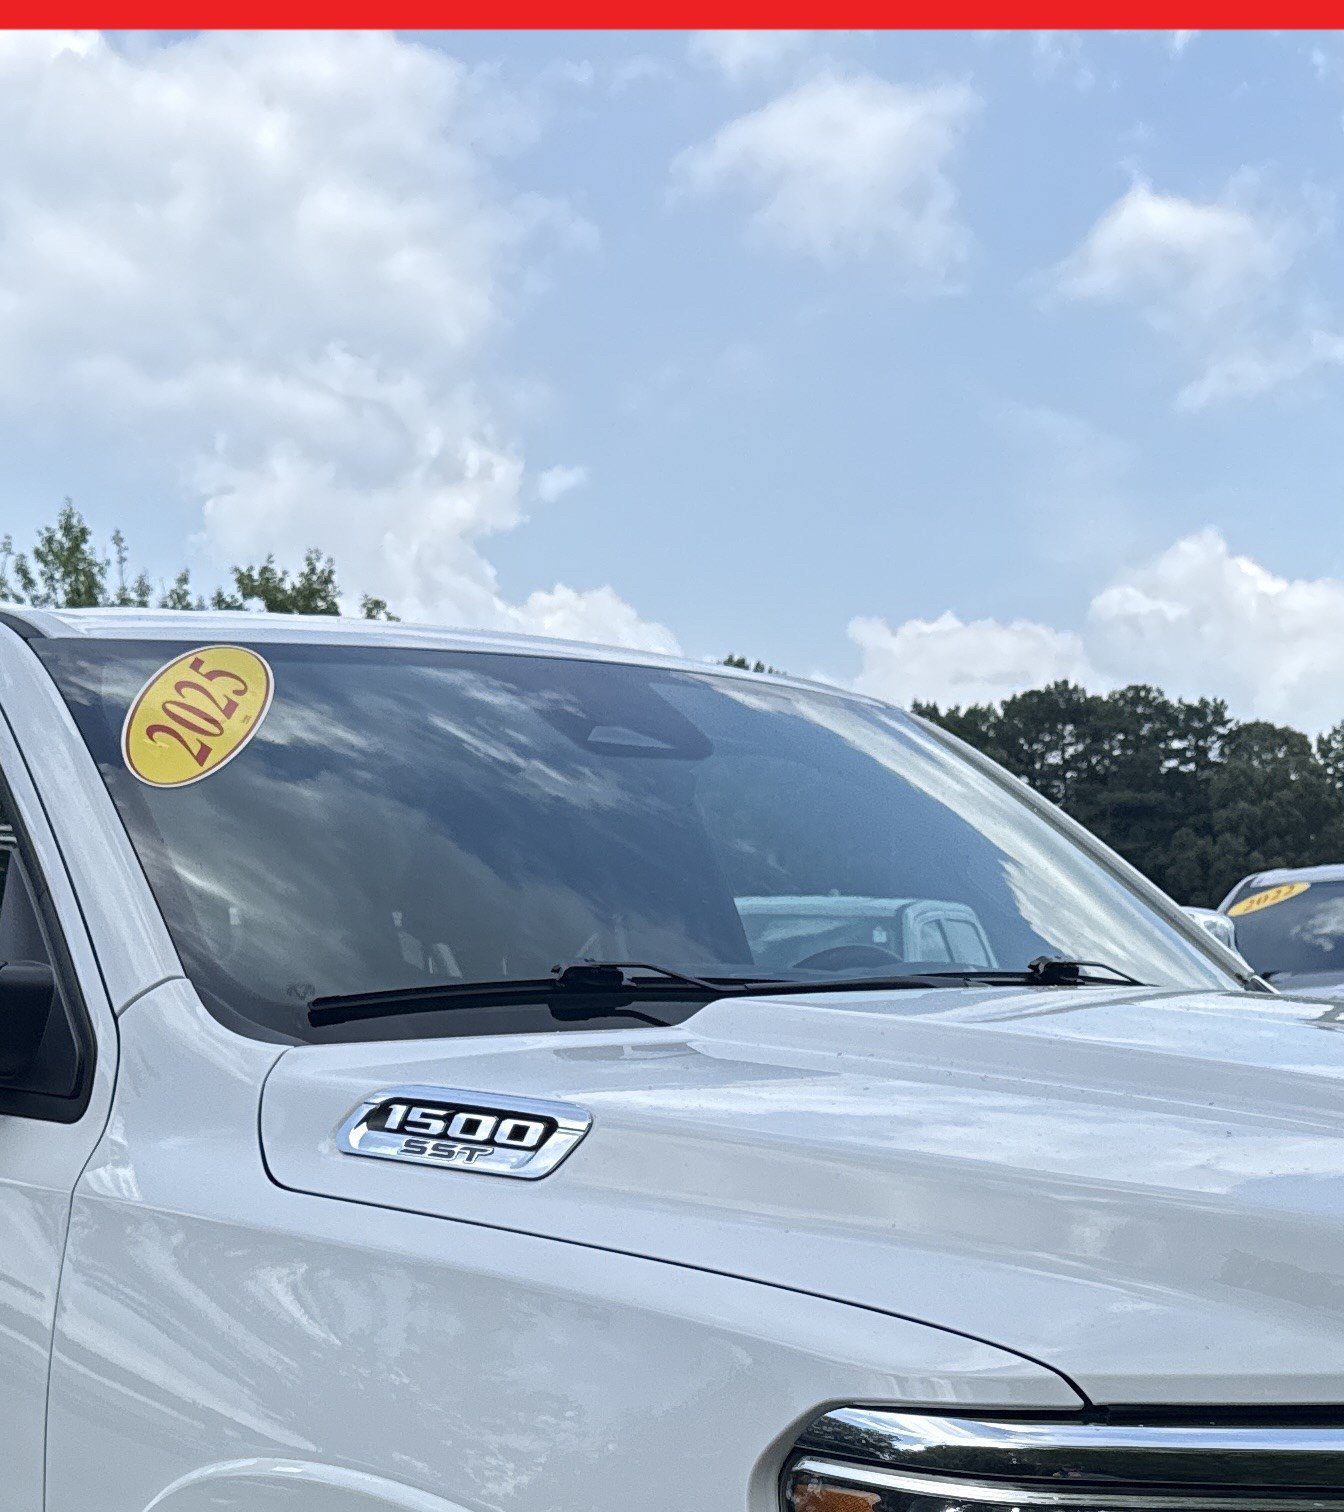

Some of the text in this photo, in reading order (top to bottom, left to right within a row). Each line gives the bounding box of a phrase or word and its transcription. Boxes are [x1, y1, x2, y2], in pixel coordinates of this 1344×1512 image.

[145, 657, 248, 767] 2025
[384, 1104, 550, 1149] 1500
[398, 1137, 494, 1164] SST
